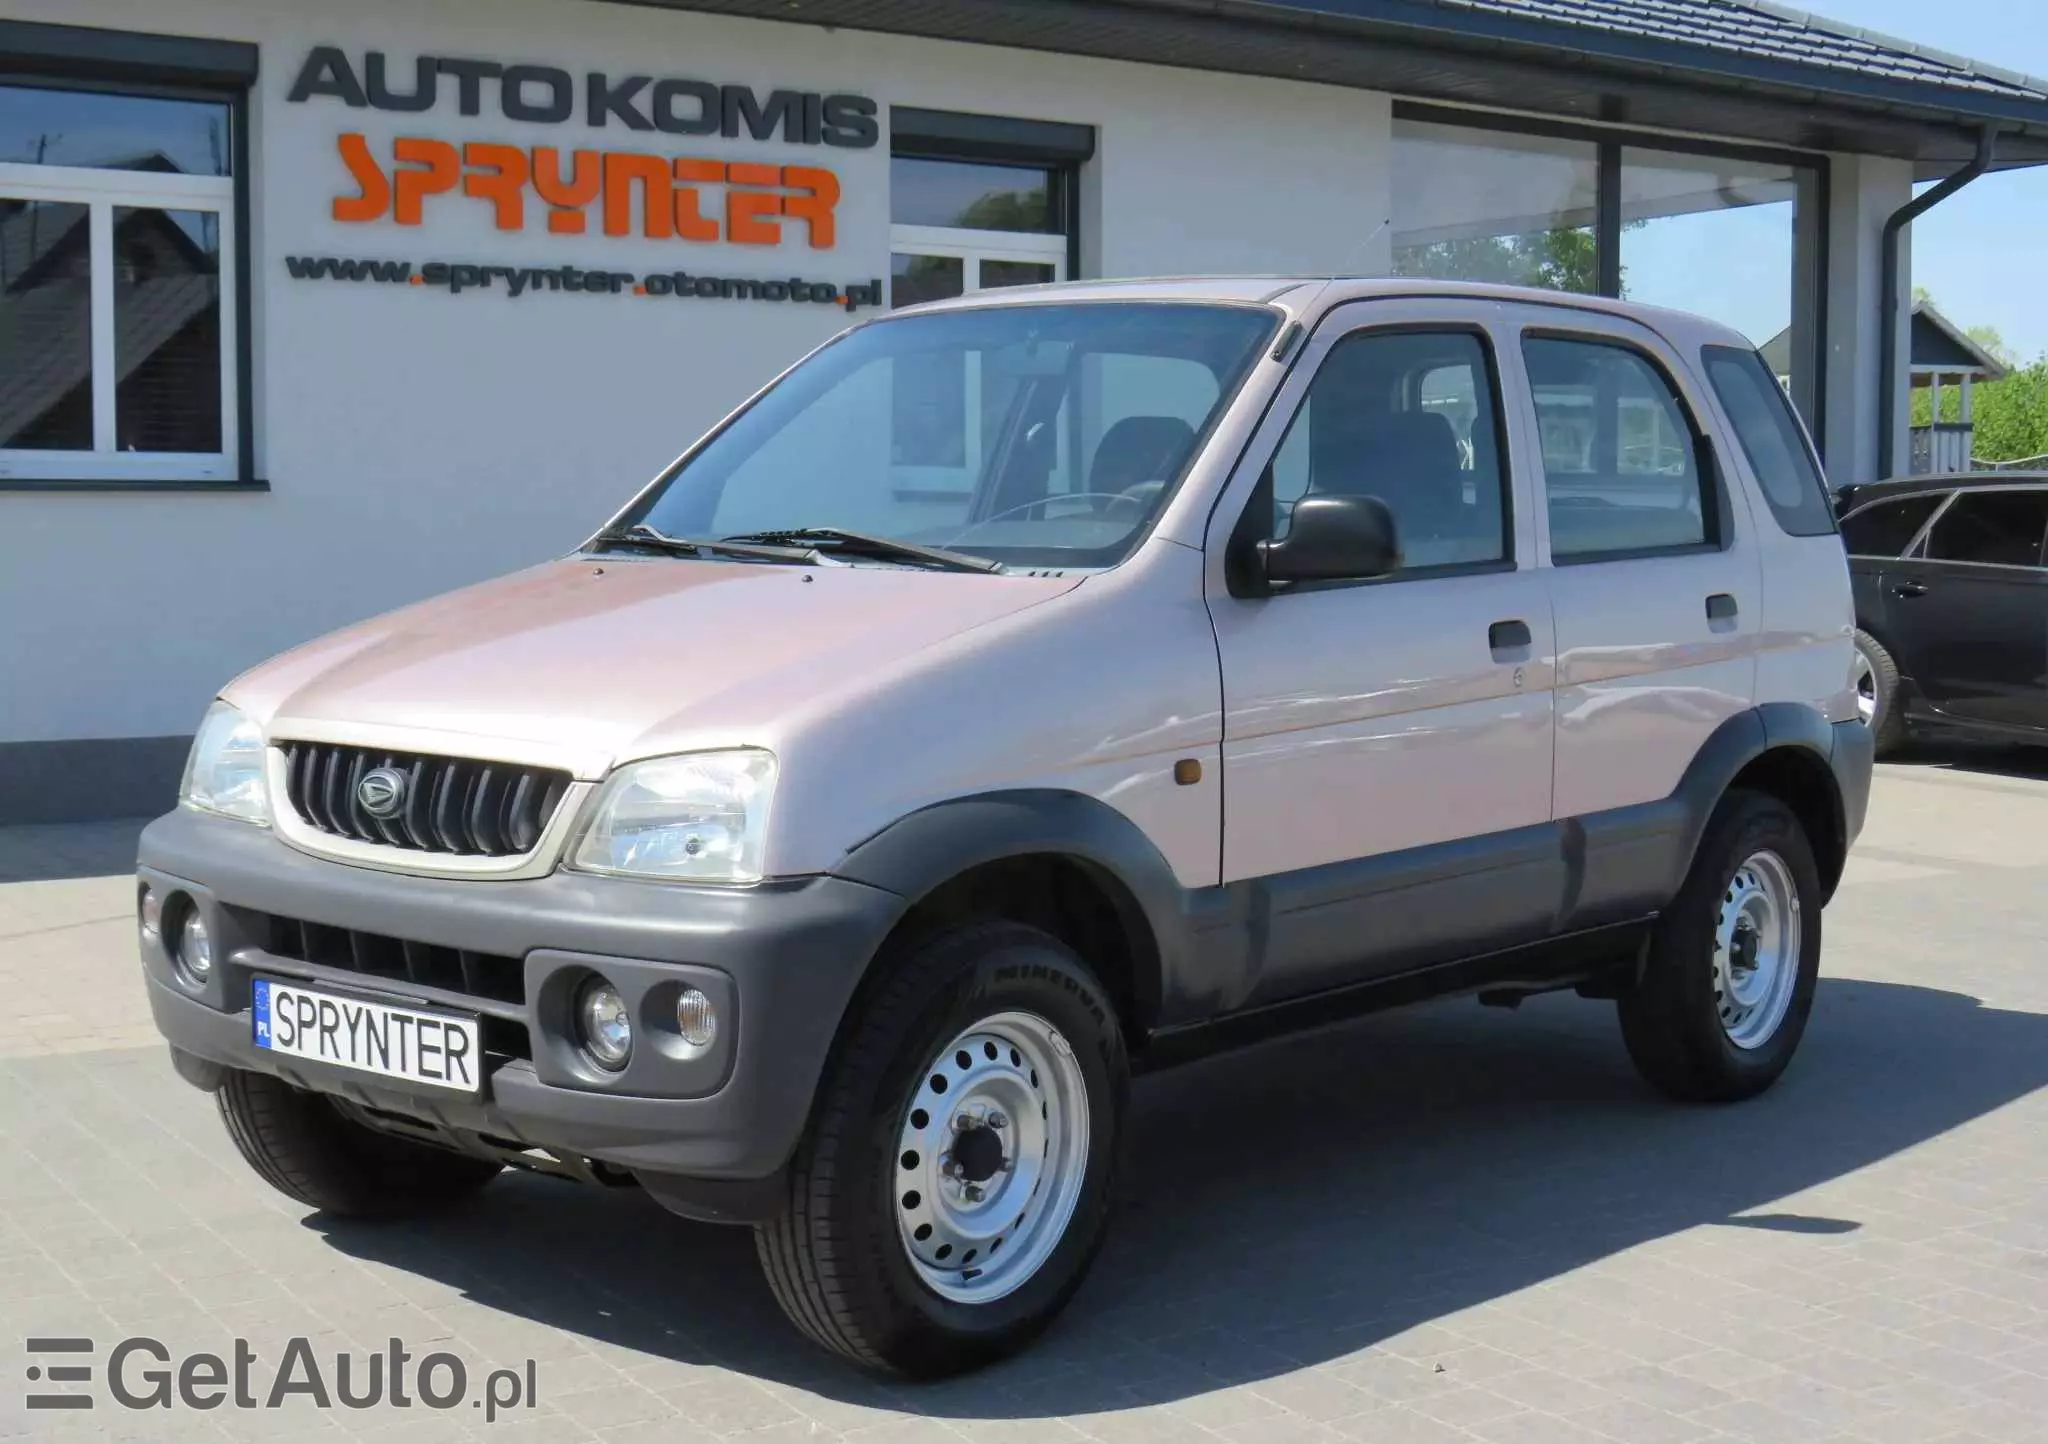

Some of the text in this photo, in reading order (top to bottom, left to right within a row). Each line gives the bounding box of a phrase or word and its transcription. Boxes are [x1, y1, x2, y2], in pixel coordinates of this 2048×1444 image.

[286, 46, 879, 148] AUTO KOMIS
[332, 132, 841, 249] SPRYNTER
[286, 255, 882, 312] www.sprynter.otomoto.pl
[257, 1020, 270, 1037] PL
[276, 991, 471, 1084] SPRYNTER
